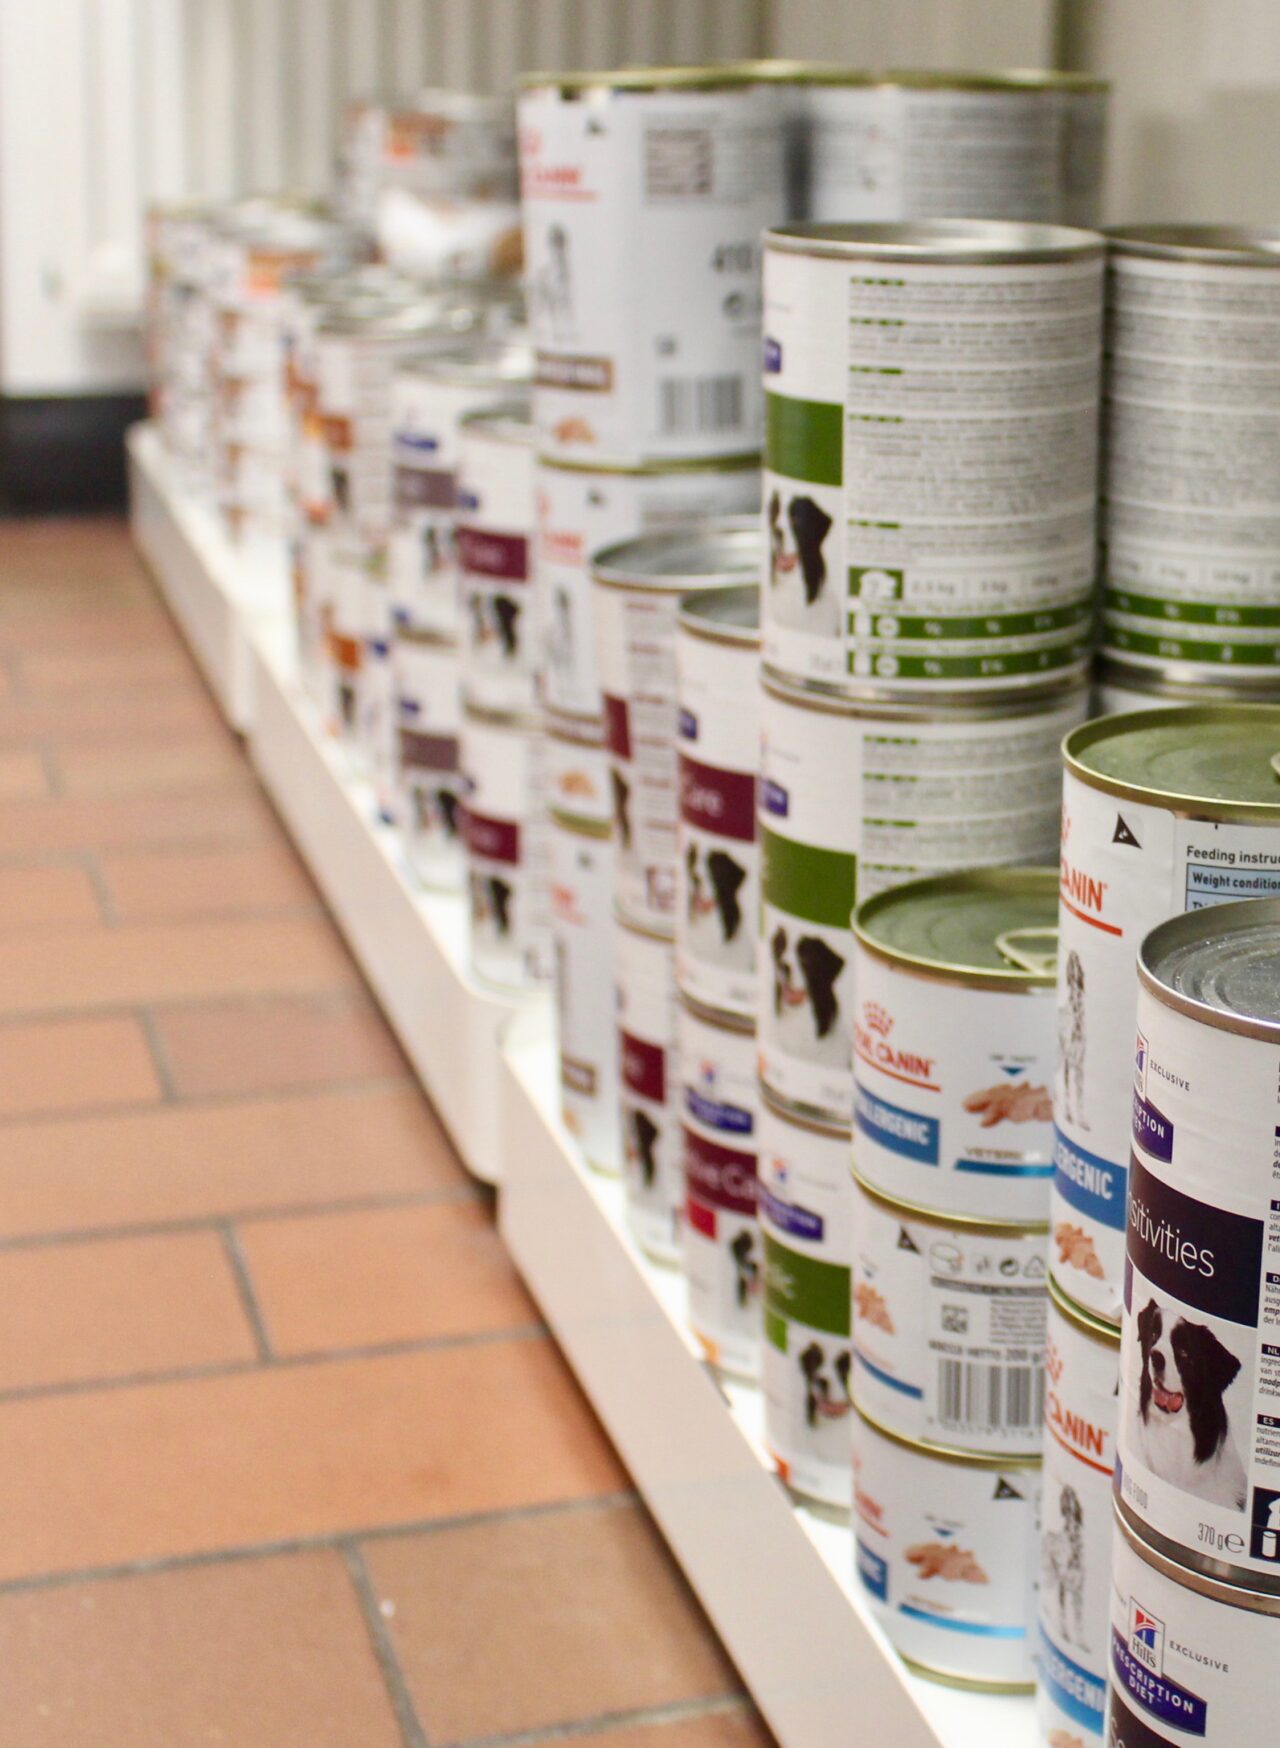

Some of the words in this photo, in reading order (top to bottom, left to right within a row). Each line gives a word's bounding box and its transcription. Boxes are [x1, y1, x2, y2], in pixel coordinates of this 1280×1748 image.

[1186, 845, 1236, 865] Feeding
[1060, 855, 1103, 913] ANIN
[1193, 872, 1230, 888] Weight
[1150, 1059, 1190, 1092] EXCLUSIVE
[1129, 1192, 1216, 1278] sitivities
[1268, 1347, 1280, 1356] NL
[1263, 1417, 1274, 1426] ES
[1198, 1522, 1216, 1546] 370
[1168, 1639, 1230, 1673] EXCLUSIVE
